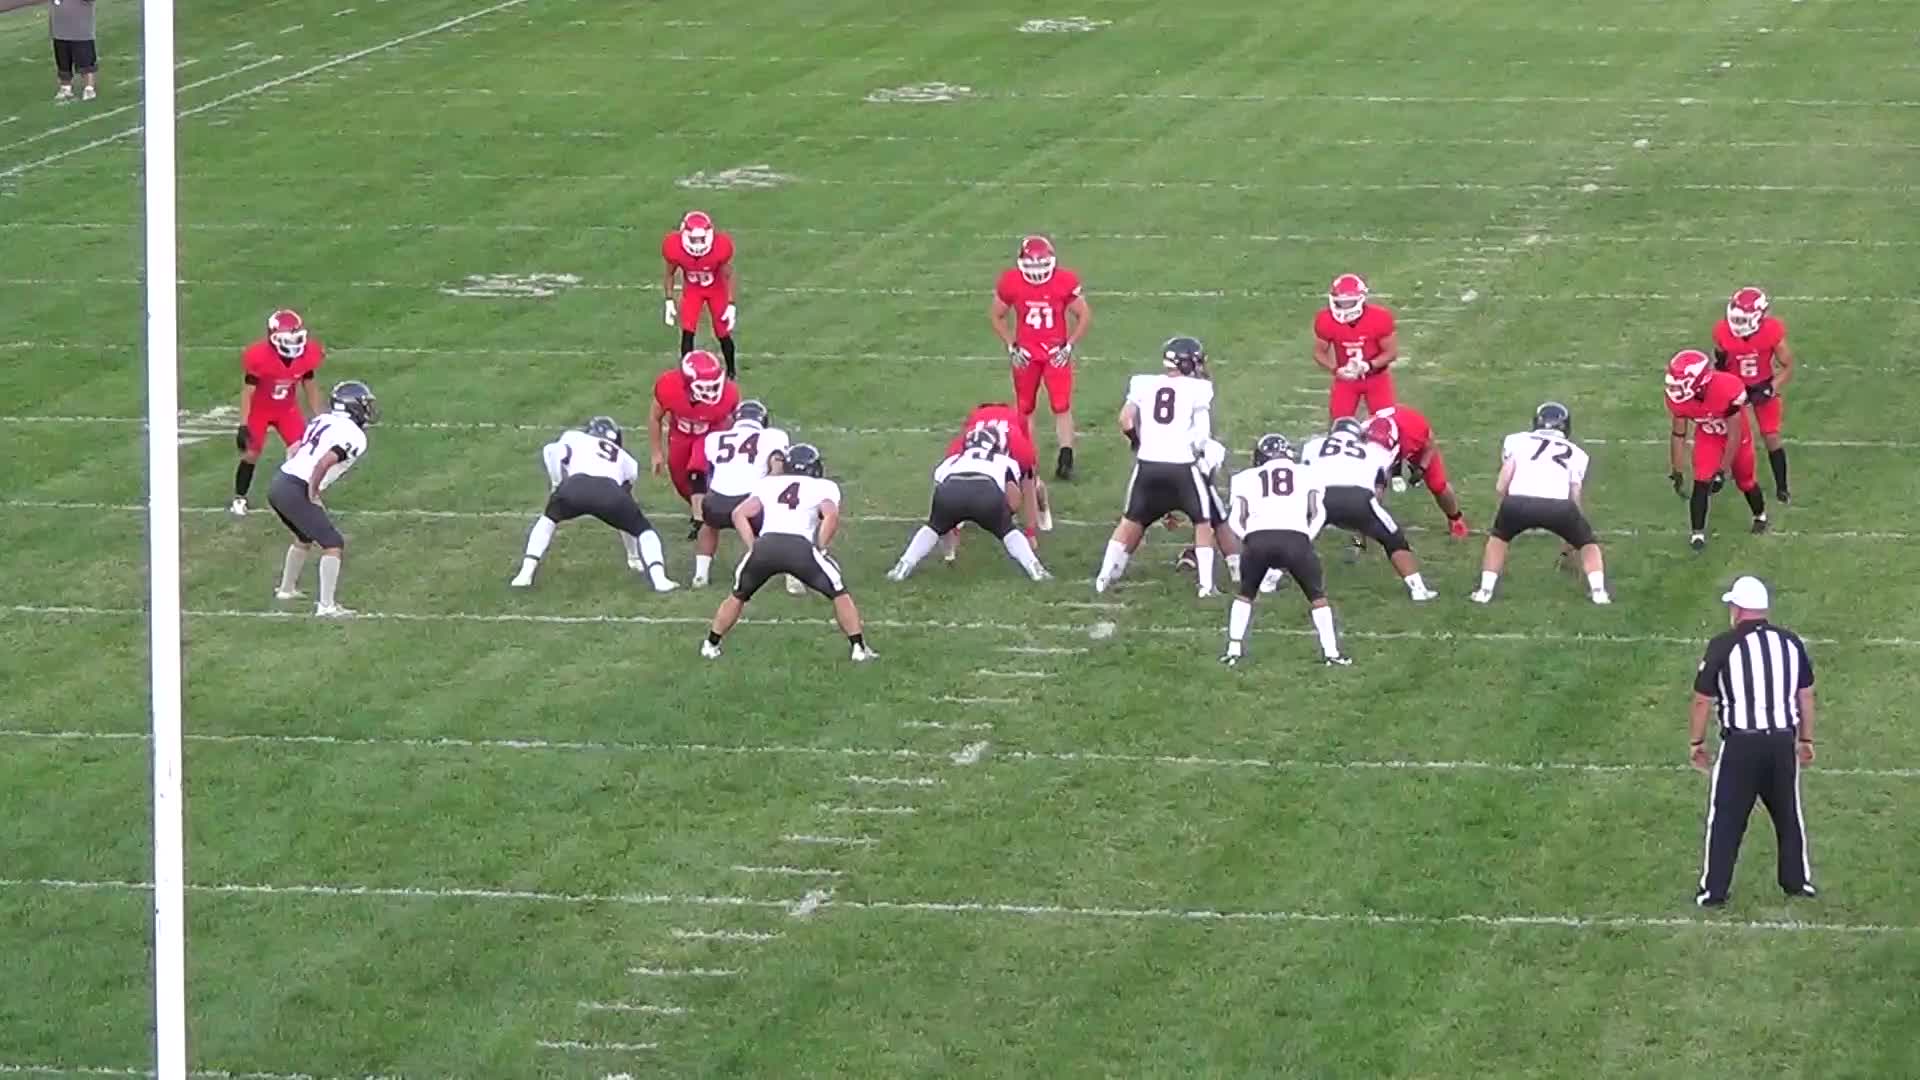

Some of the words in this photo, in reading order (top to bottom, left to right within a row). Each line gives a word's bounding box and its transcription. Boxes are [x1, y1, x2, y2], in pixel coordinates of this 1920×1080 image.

[1025, 307, 1053, 329] 41
[1153, 387, 1175, 425] 8
[596, 440, 619, 463] 9
[715, 433, 760, 464] 54
[1319, 437, 1367, 460] 65
[1529, 436, 1573, 470] 72
[777, 482, 800, 510] 4
[1258, 468, 1294, 498] 18
